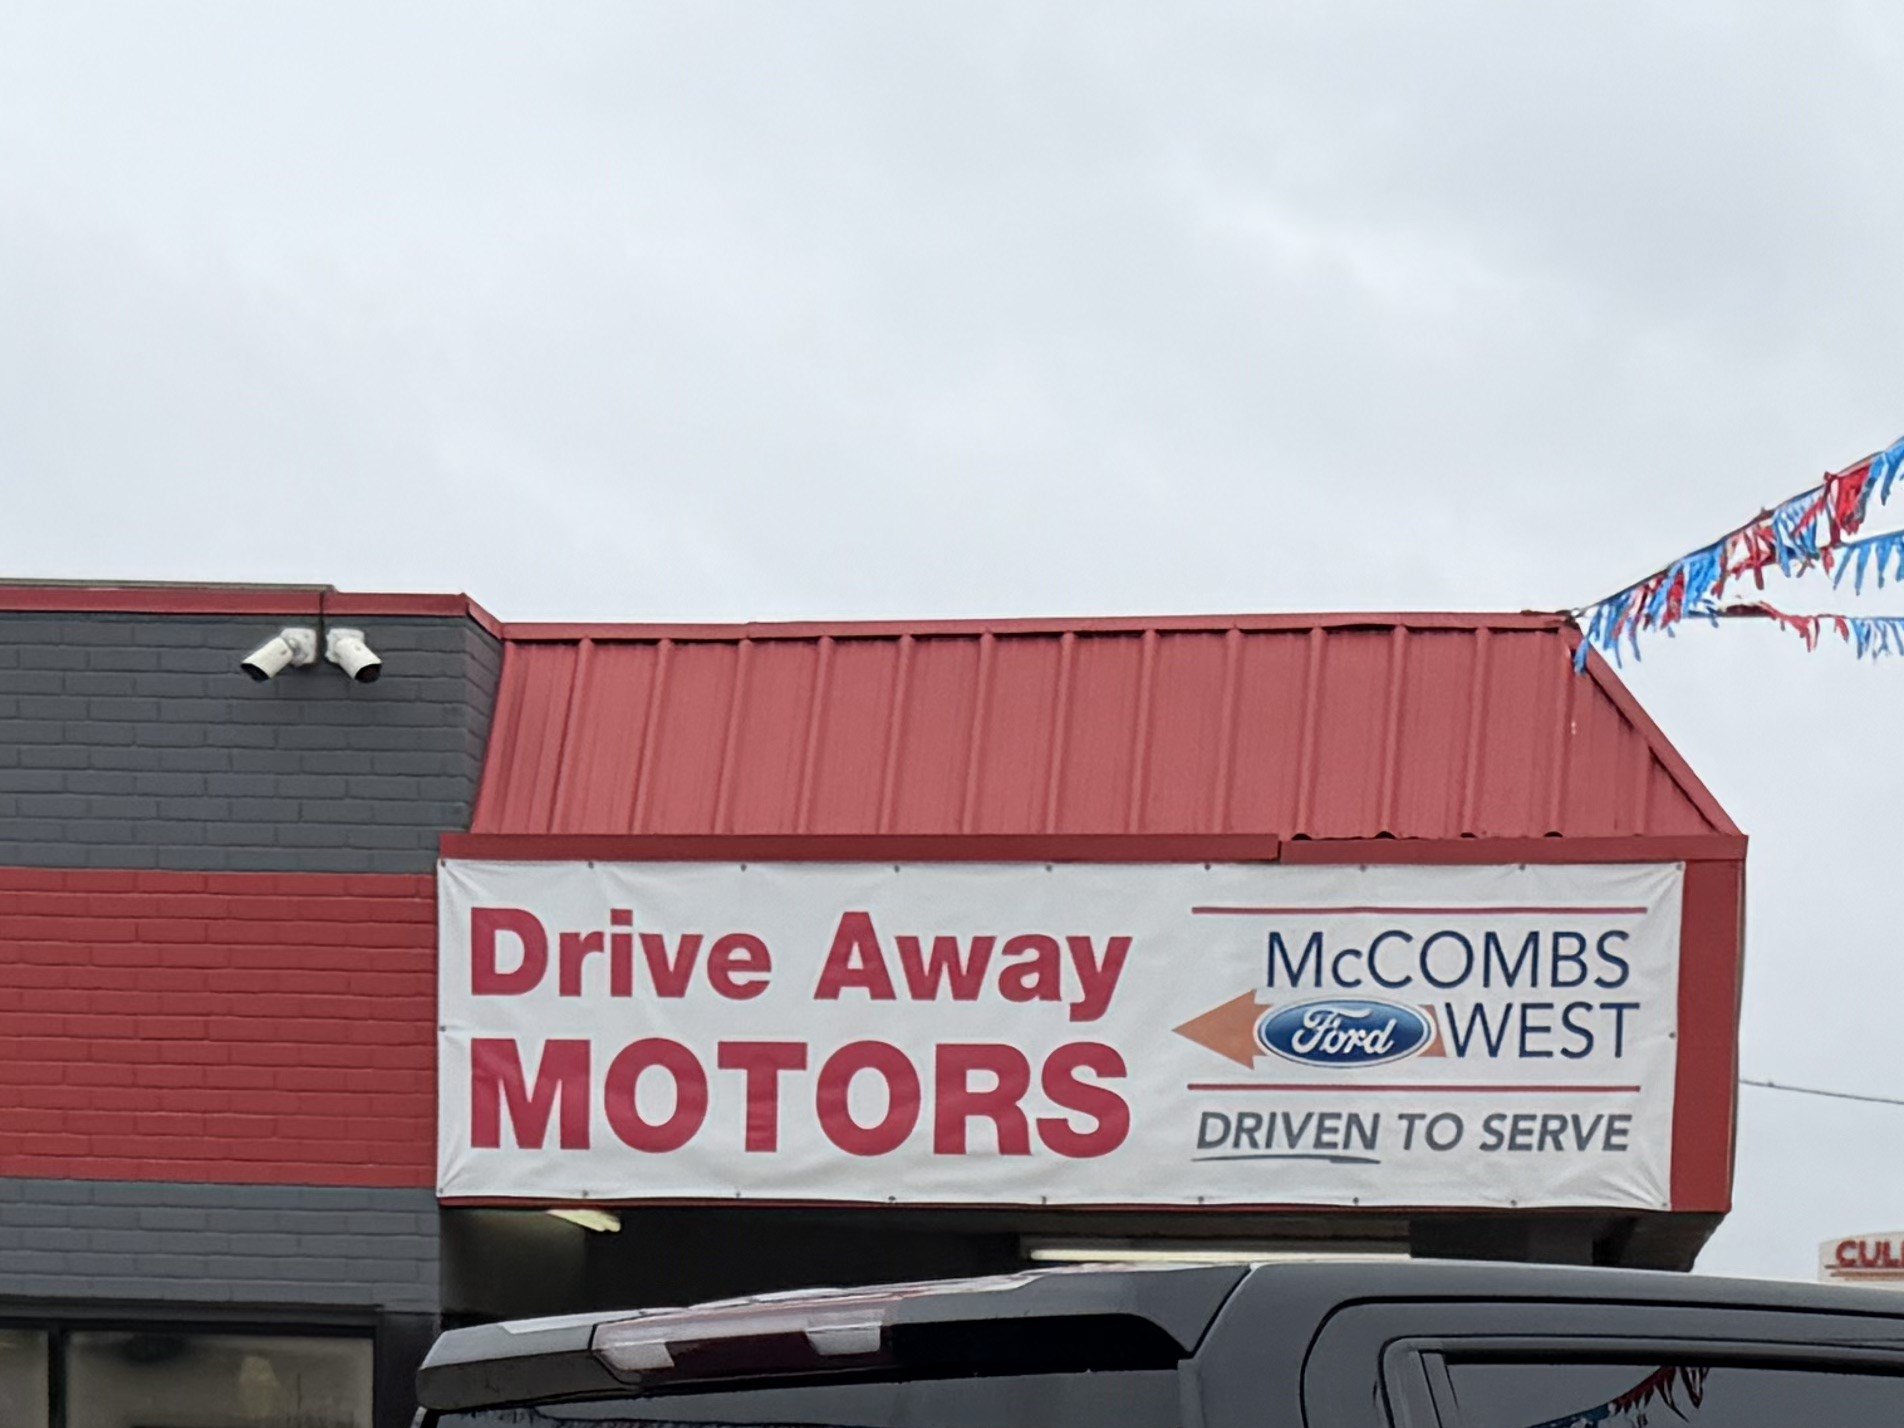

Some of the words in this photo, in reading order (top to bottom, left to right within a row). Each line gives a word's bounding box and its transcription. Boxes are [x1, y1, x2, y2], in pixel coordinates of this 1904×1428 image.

[469, 906, 773, 1001] Drive
[813, 910, 1133, 1023] Away
[1265, 929, 1630, 989] McCOMBS
[1290, 1007, 1396, 1058] Ford
[1445, 1001, 1641, 1059] WEST
[469, 1036, 1131, 1159] MOTORS
[1196, 1112, 1382, 1152] DRIVEN
[1397, 1112, 1465, 1153] TO
[1479, 1112, 1633, 1153] SERVE
